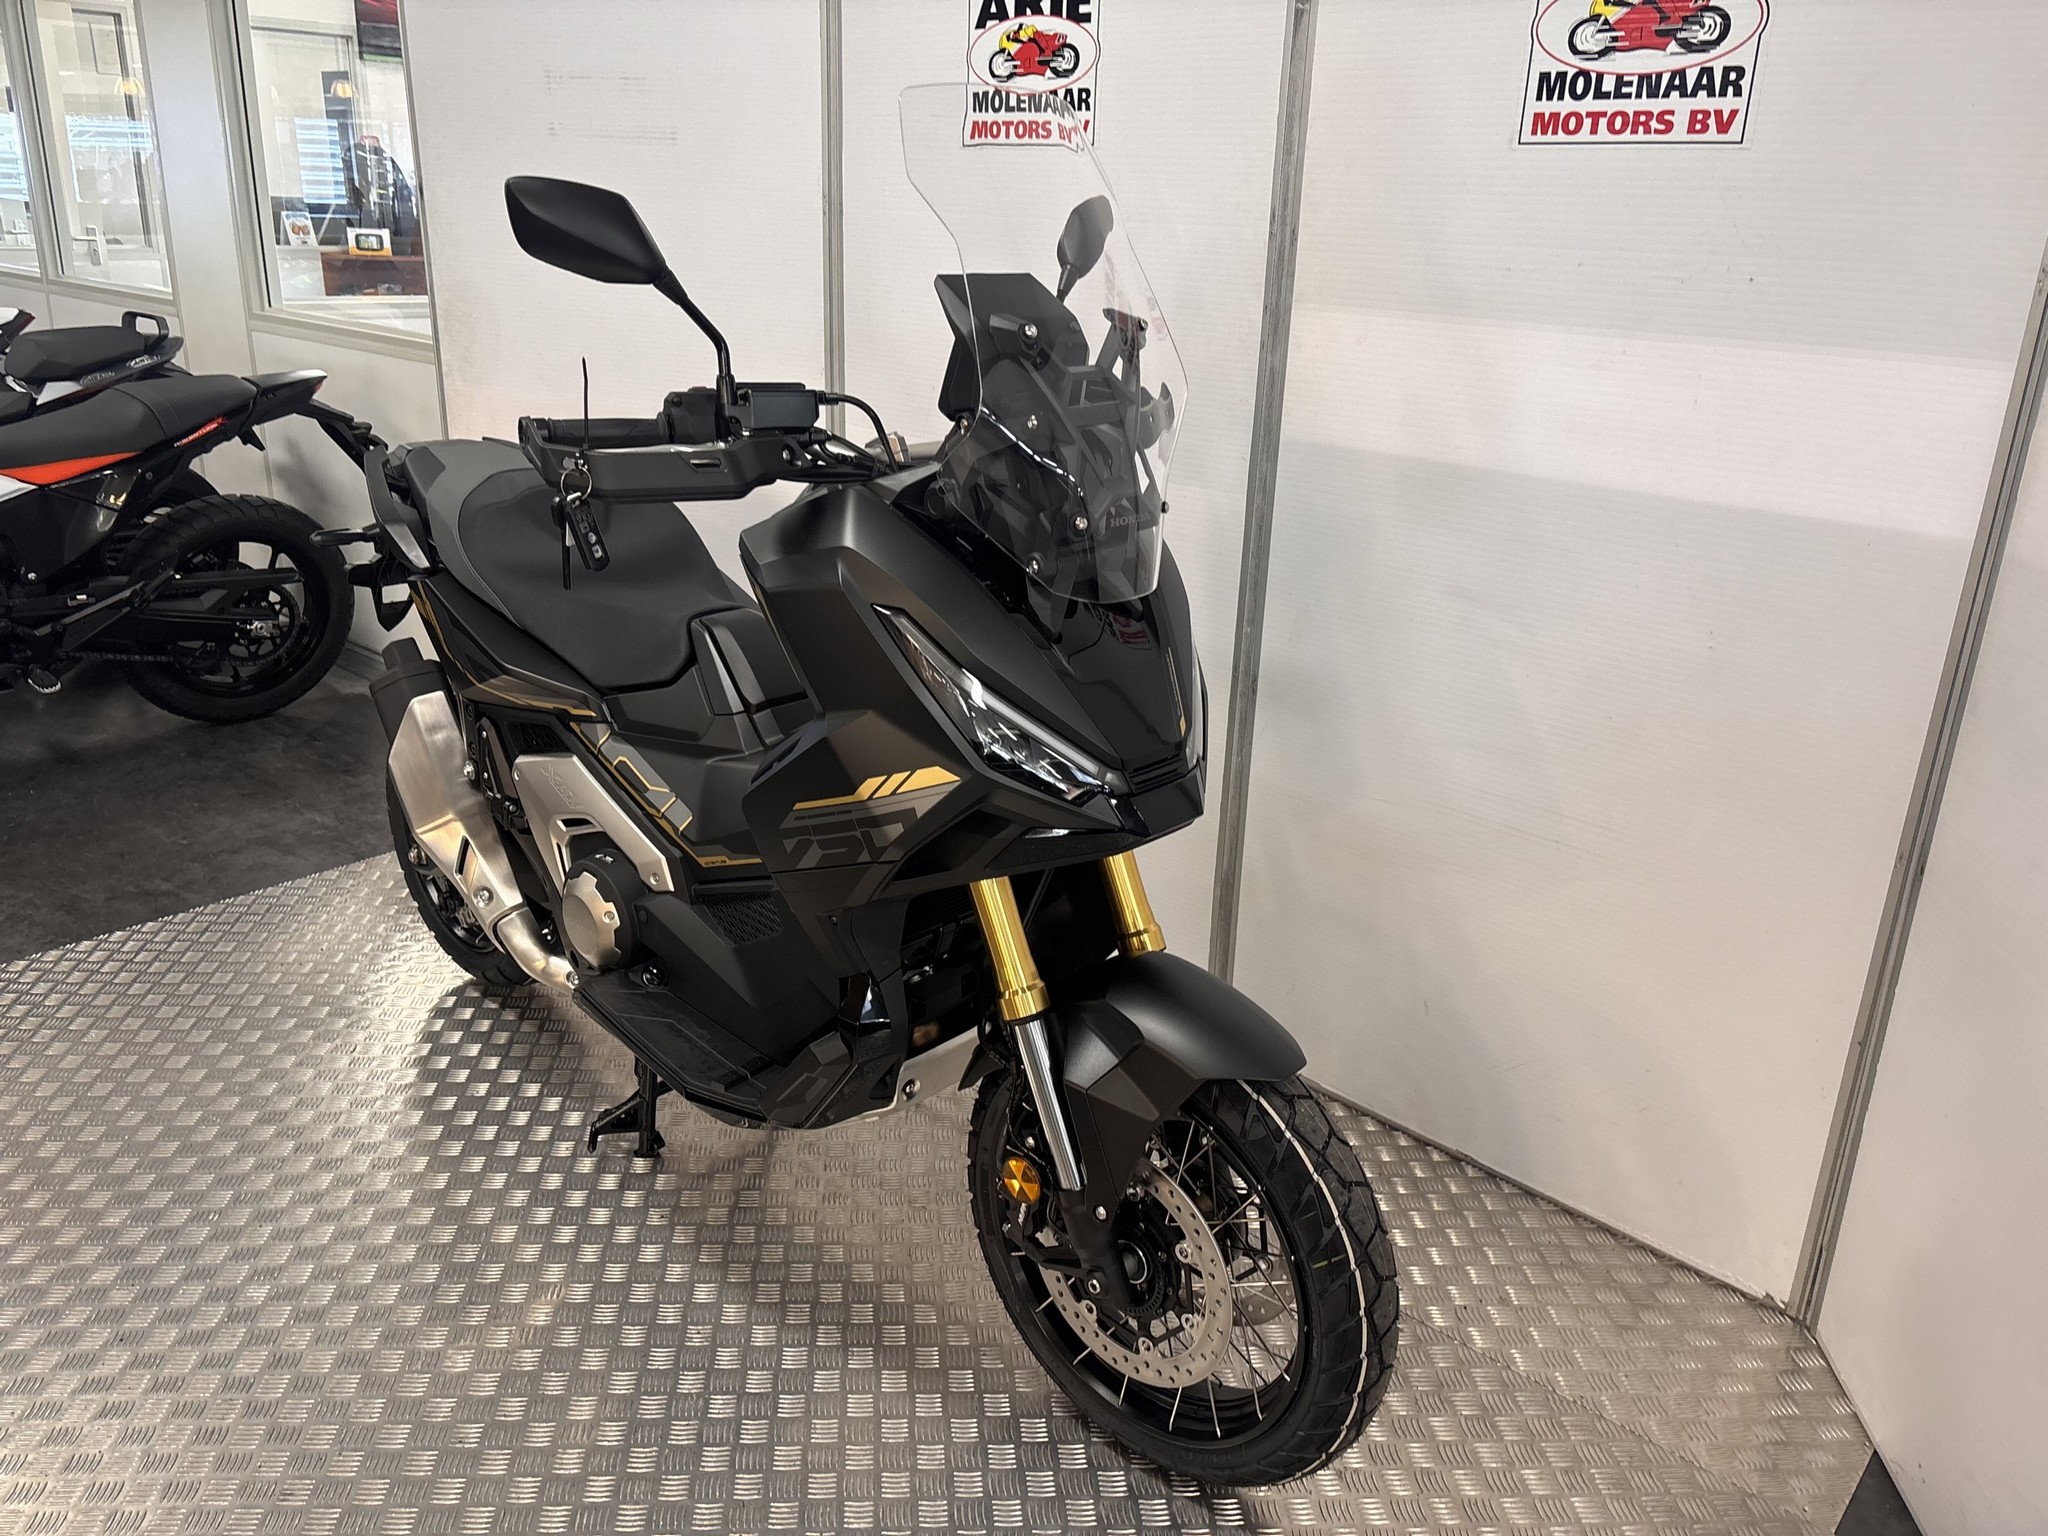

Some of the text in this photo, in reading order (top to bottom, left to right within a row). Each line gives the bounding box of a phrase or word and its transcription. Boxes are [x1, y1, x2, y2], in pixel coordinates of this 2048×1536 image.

[975, 0, 1091, 29] ARIE
[1535, 65, 1746, 102] MOLENAAR
[969, 120, 1053, 140] MOTORS
[1530, 108, 1740, 136] MOTORS BV
[1109, 513, 1151, 527] HONDA
